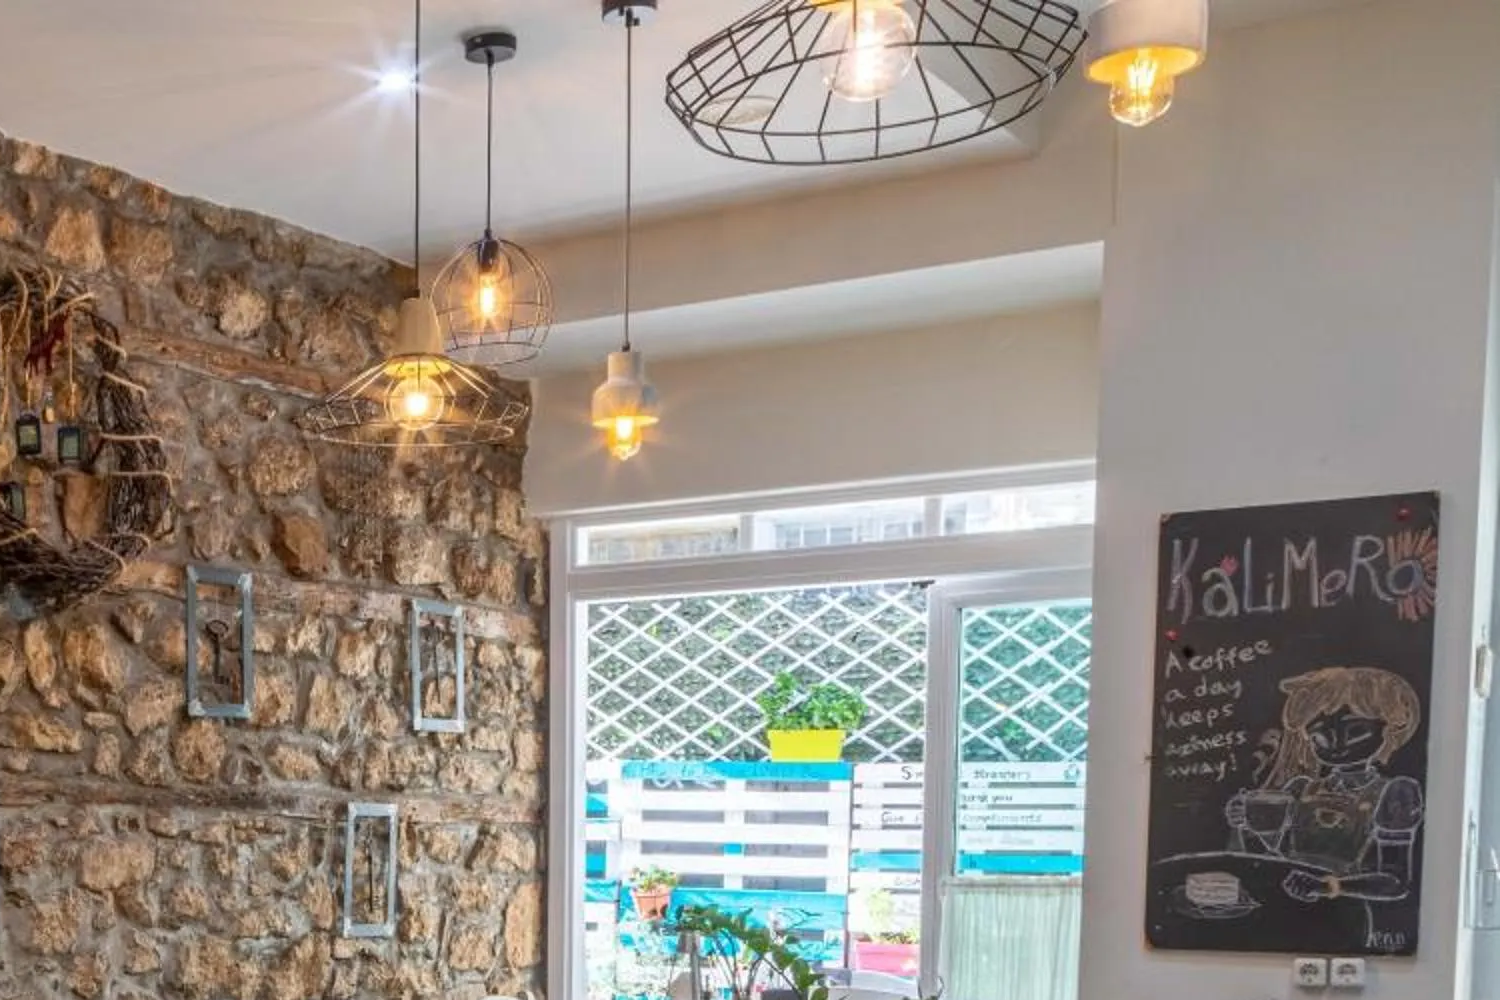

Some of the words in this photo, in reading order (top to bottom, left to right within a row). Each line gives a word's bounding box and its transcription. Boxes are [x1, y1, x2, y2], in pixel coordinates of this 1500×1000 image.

[1165, 650, 1182, 678] A
[1188, 640, 1272, 671] coffee
[1165, 689, 1187, 702] a
[1194, 675, 1242, 699] day
[1161, 703, 1234, 728] keeps
